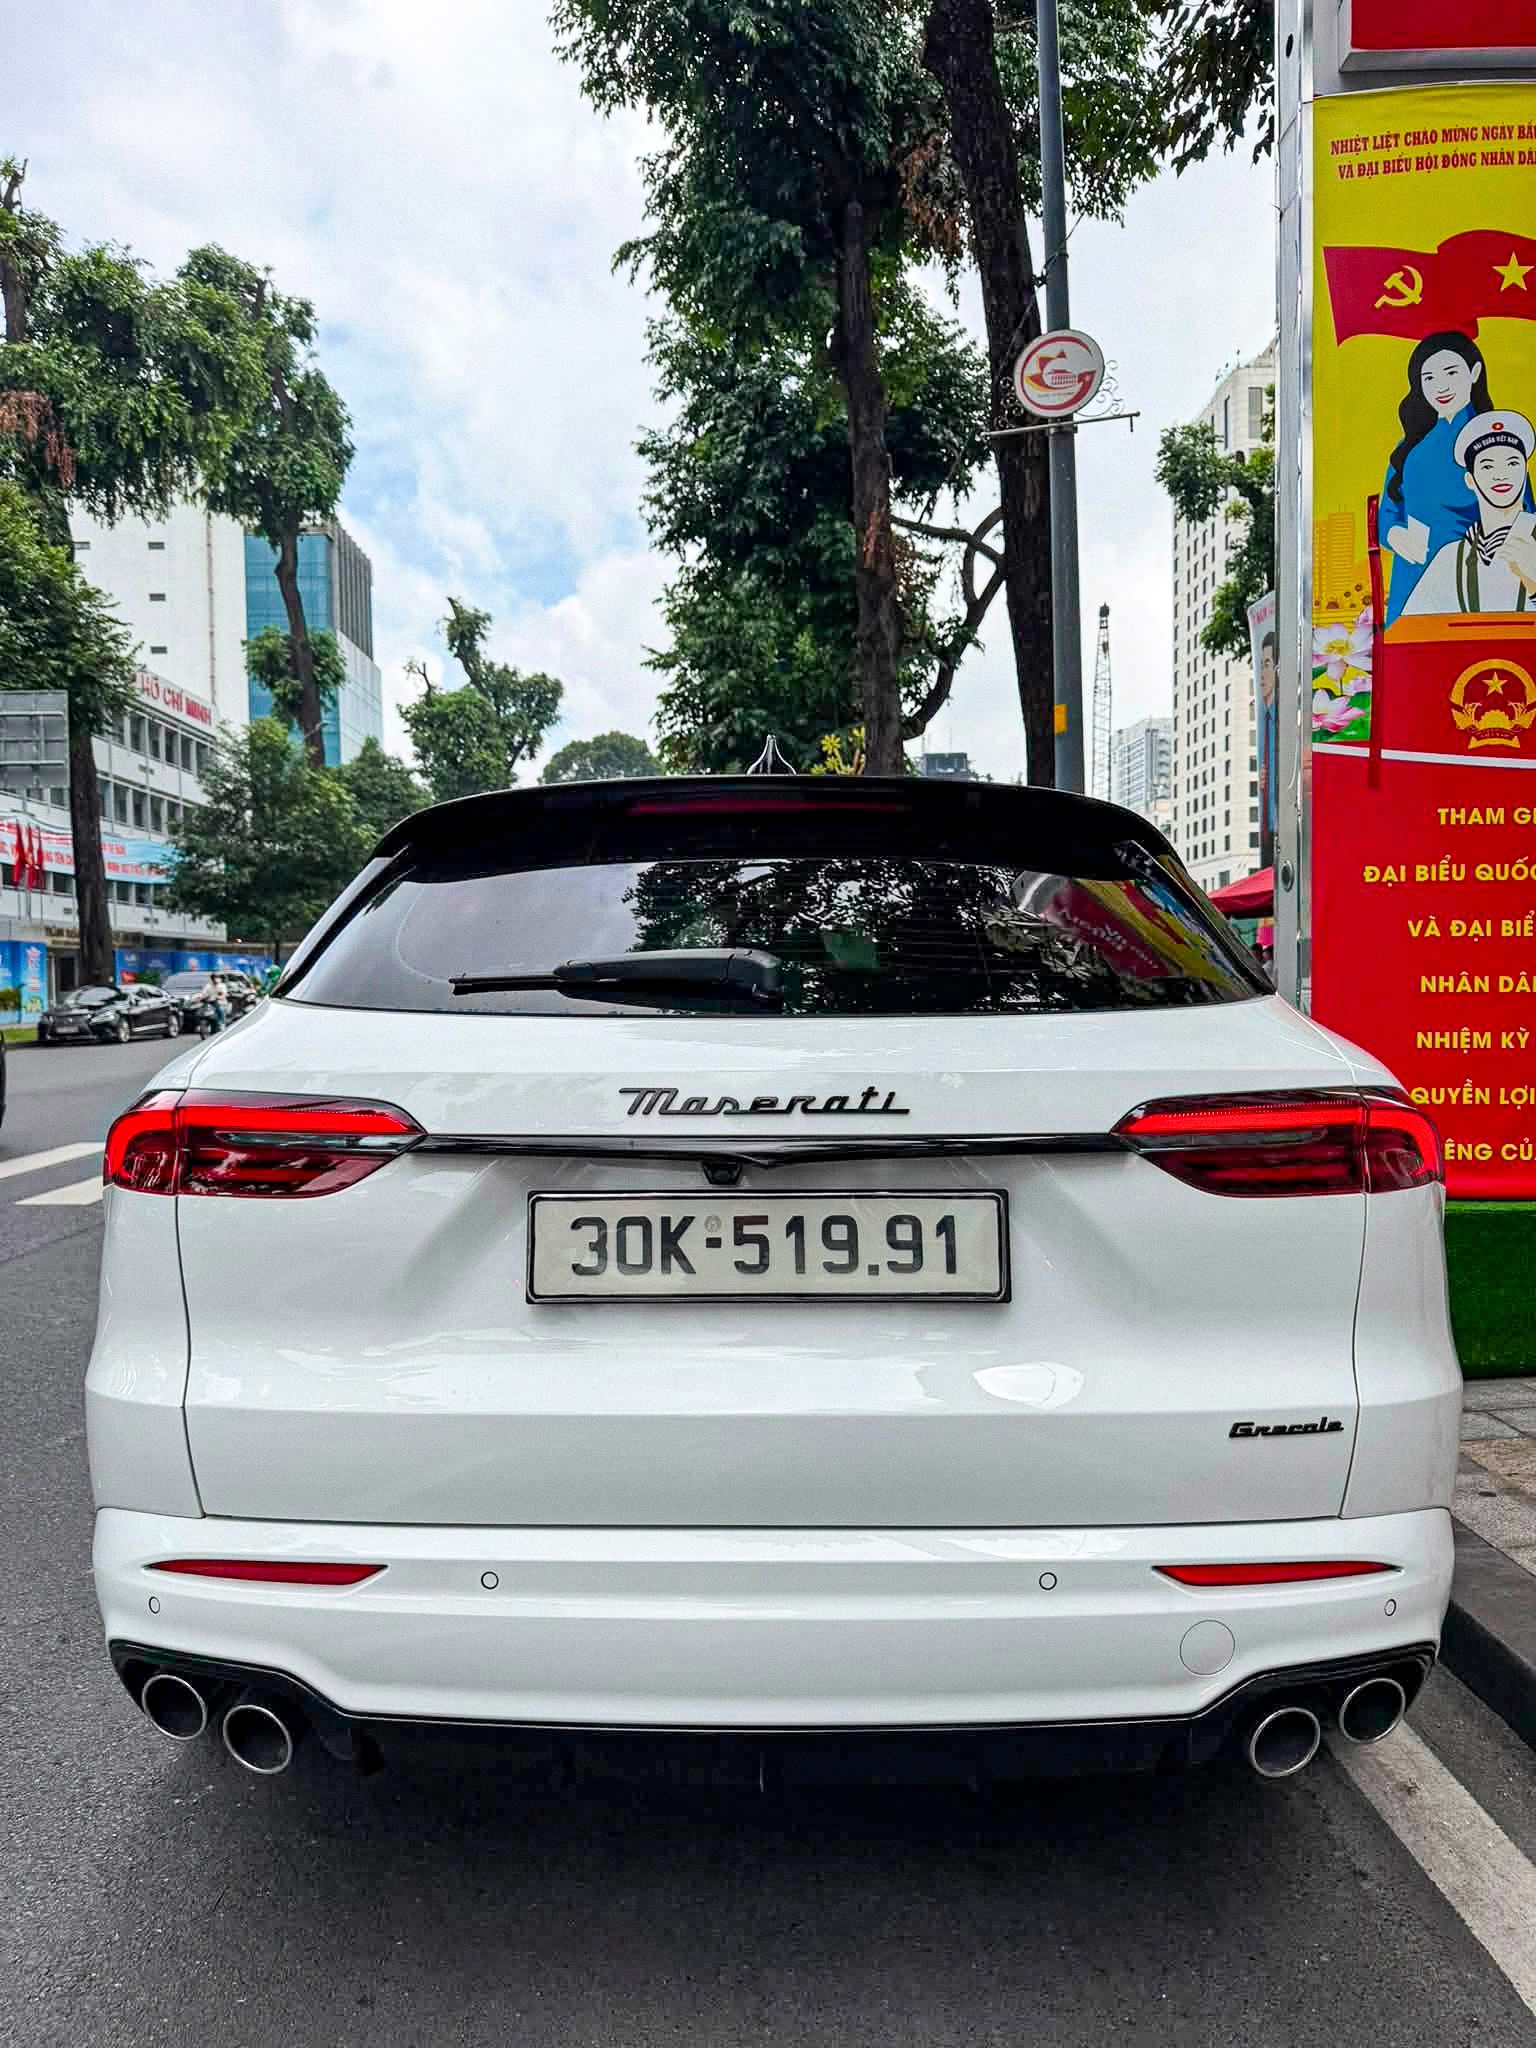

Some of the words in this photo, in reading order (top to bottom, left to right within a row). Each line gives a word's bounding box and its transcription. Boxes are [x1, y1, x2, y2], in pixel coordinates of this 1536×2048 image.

[1330, 133, 1369, 156] NHIỆT
[1372, 130, 1400, 152] LIỆT
[1403, 127, 1438, 147] CHÀO
[1441, 124, 1478, 143] MỪNG
[1481, 121, 1514, 141] NGÀY
[1517, 119, 1536, 139] BẦ
[1338, 160, 1354, 179] VÀ
[1357, 161, 1379, 179] ĐẠI
[1382, 152, 1412, 175] BIỂU
[1415, 152, 1438, 173] HỘI
[1441, 147, 1477, 169] ĐỒNG
[1480, 147, 1515, 167] NHÂN
[1517, 147, 1536, 166] DÂ
[1437, 807, 1505, 825] THAM
[1363, 865, 1407, 887] ĐẠI
[1415, 854, 1466, 882] BIỂU
[1407, 915, 1441, 937] VÀ
[1450, 919, 1492, 942] ĐẠI
[1501, 910, 1535, 937] BIỂ
[1420, 971, 1490, 993] NHÂN
[1498, 971, 1536, 993] DÂ
[1416, 1027, 1492, 1054] NHIỆM
[1501, 1027, 1530, 1049] KỲ
[619, 1086, 911, 1116] Maserati
[1409, 1079, 1491, 1105] QUYỀN
[1500, 1085, 1535, 1110] LỢI
[1444, 1138, 1493, 1161] ÊNG
[1501, 1137, 1536, 1161] CỦ
[571, 1215, 958, 1276] 30K-519.91
[1229, 1416, 1345, 1438] Grecale
